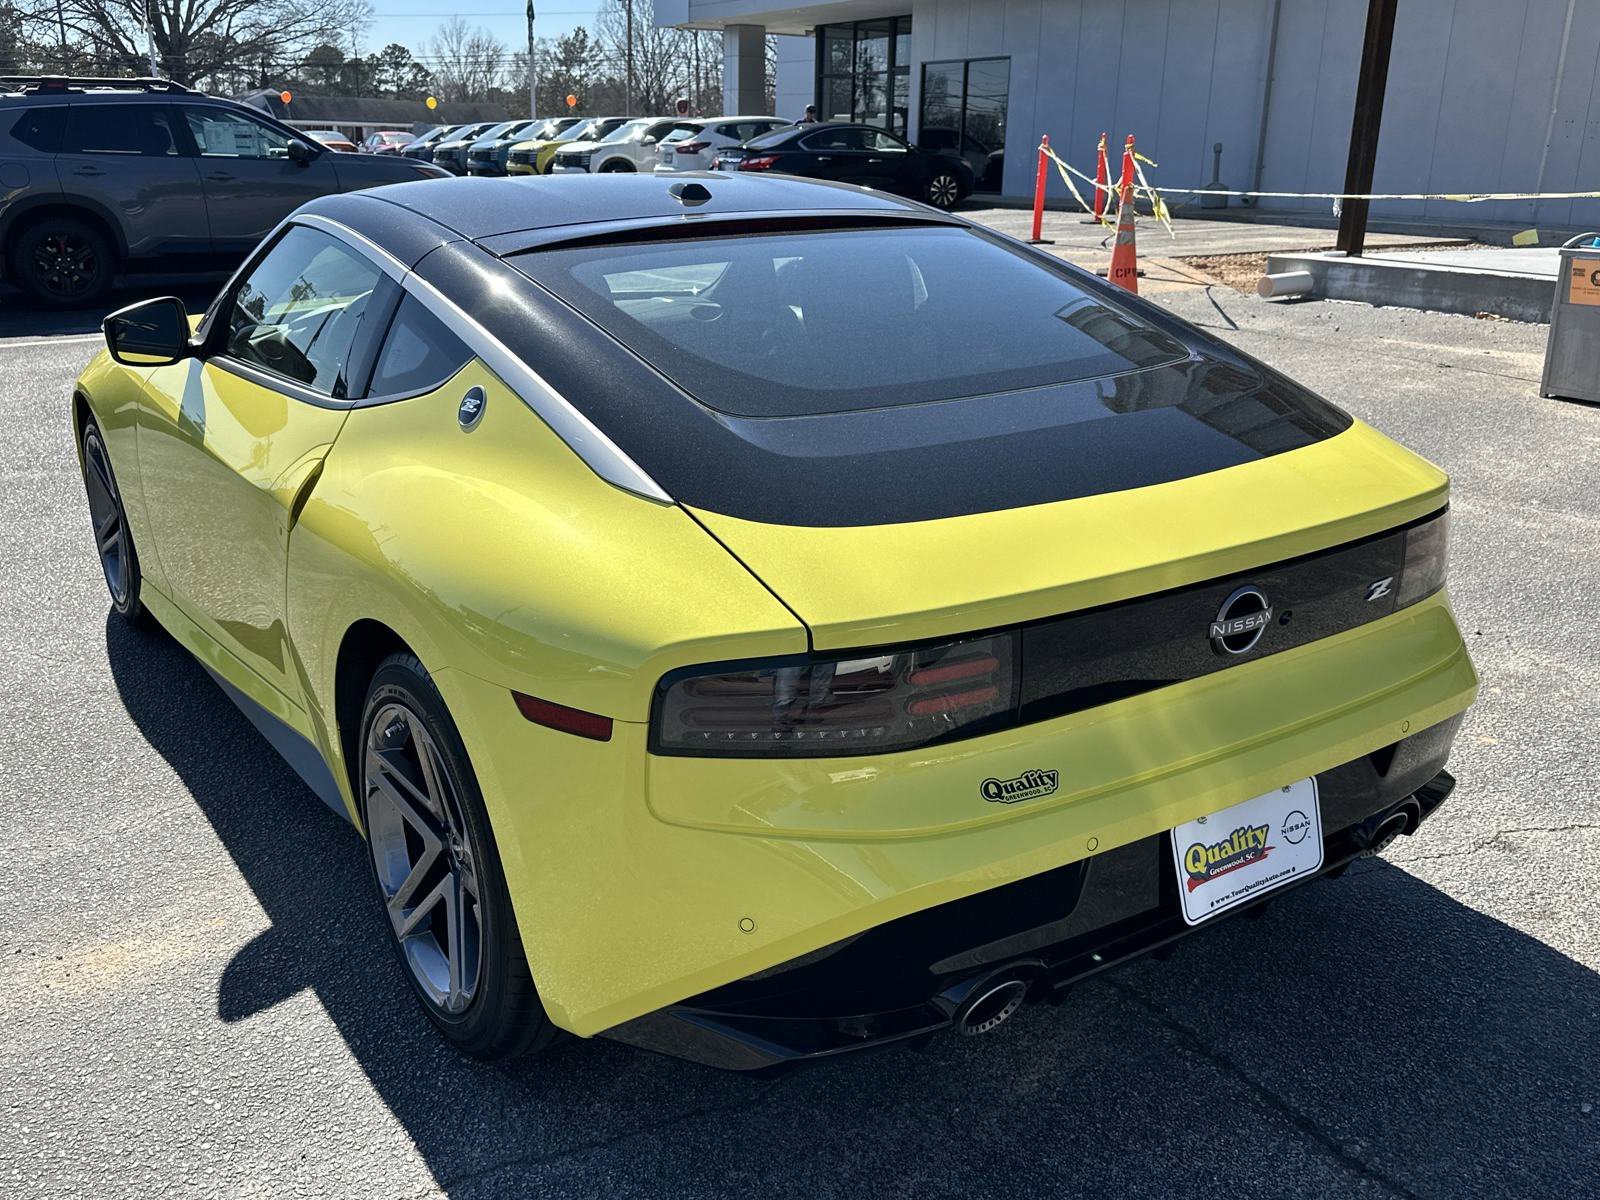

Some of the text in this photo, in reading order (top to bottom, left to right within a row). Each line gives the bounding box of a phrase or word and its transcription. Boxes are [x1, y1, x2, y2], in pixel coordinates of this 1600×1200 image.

[1367, 576, 1393, 601] Z
[1212, 611, 1272, 636] NISSAN
[983, 771, 1056, 800] Quality
[1280, 819, 1311, 836] NISSAN
[1185, 824, 1269, 874] Quality
[1209, 851, 1255, 876] Greenwood, SC
[1215, 868, 1291, 905] www.YourQualityAuto.com
